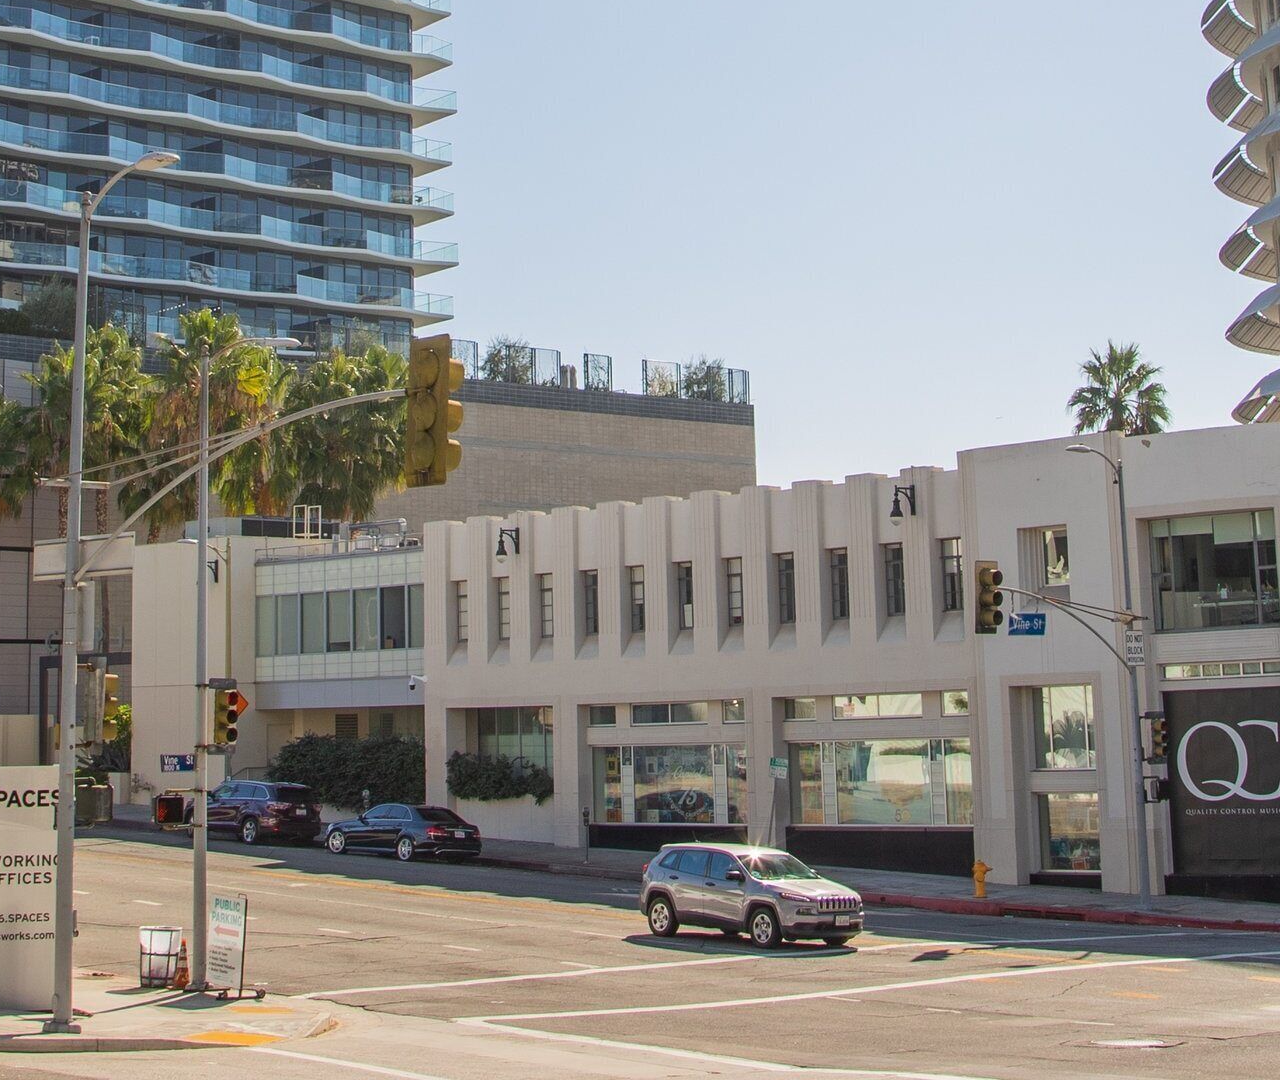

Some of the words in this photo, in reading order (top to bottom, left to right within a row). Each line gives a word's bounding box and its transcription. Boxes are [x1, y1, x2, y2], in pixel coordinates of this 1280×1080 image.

[1013, 618, 1031, 630] Vine
[1032, 618, 1042, 630] St
[1185, 808, 1218, 817] QUALITY
[215, 898, 241, 912] PUBLIC
[211, 911, 242, 927] PARKING
